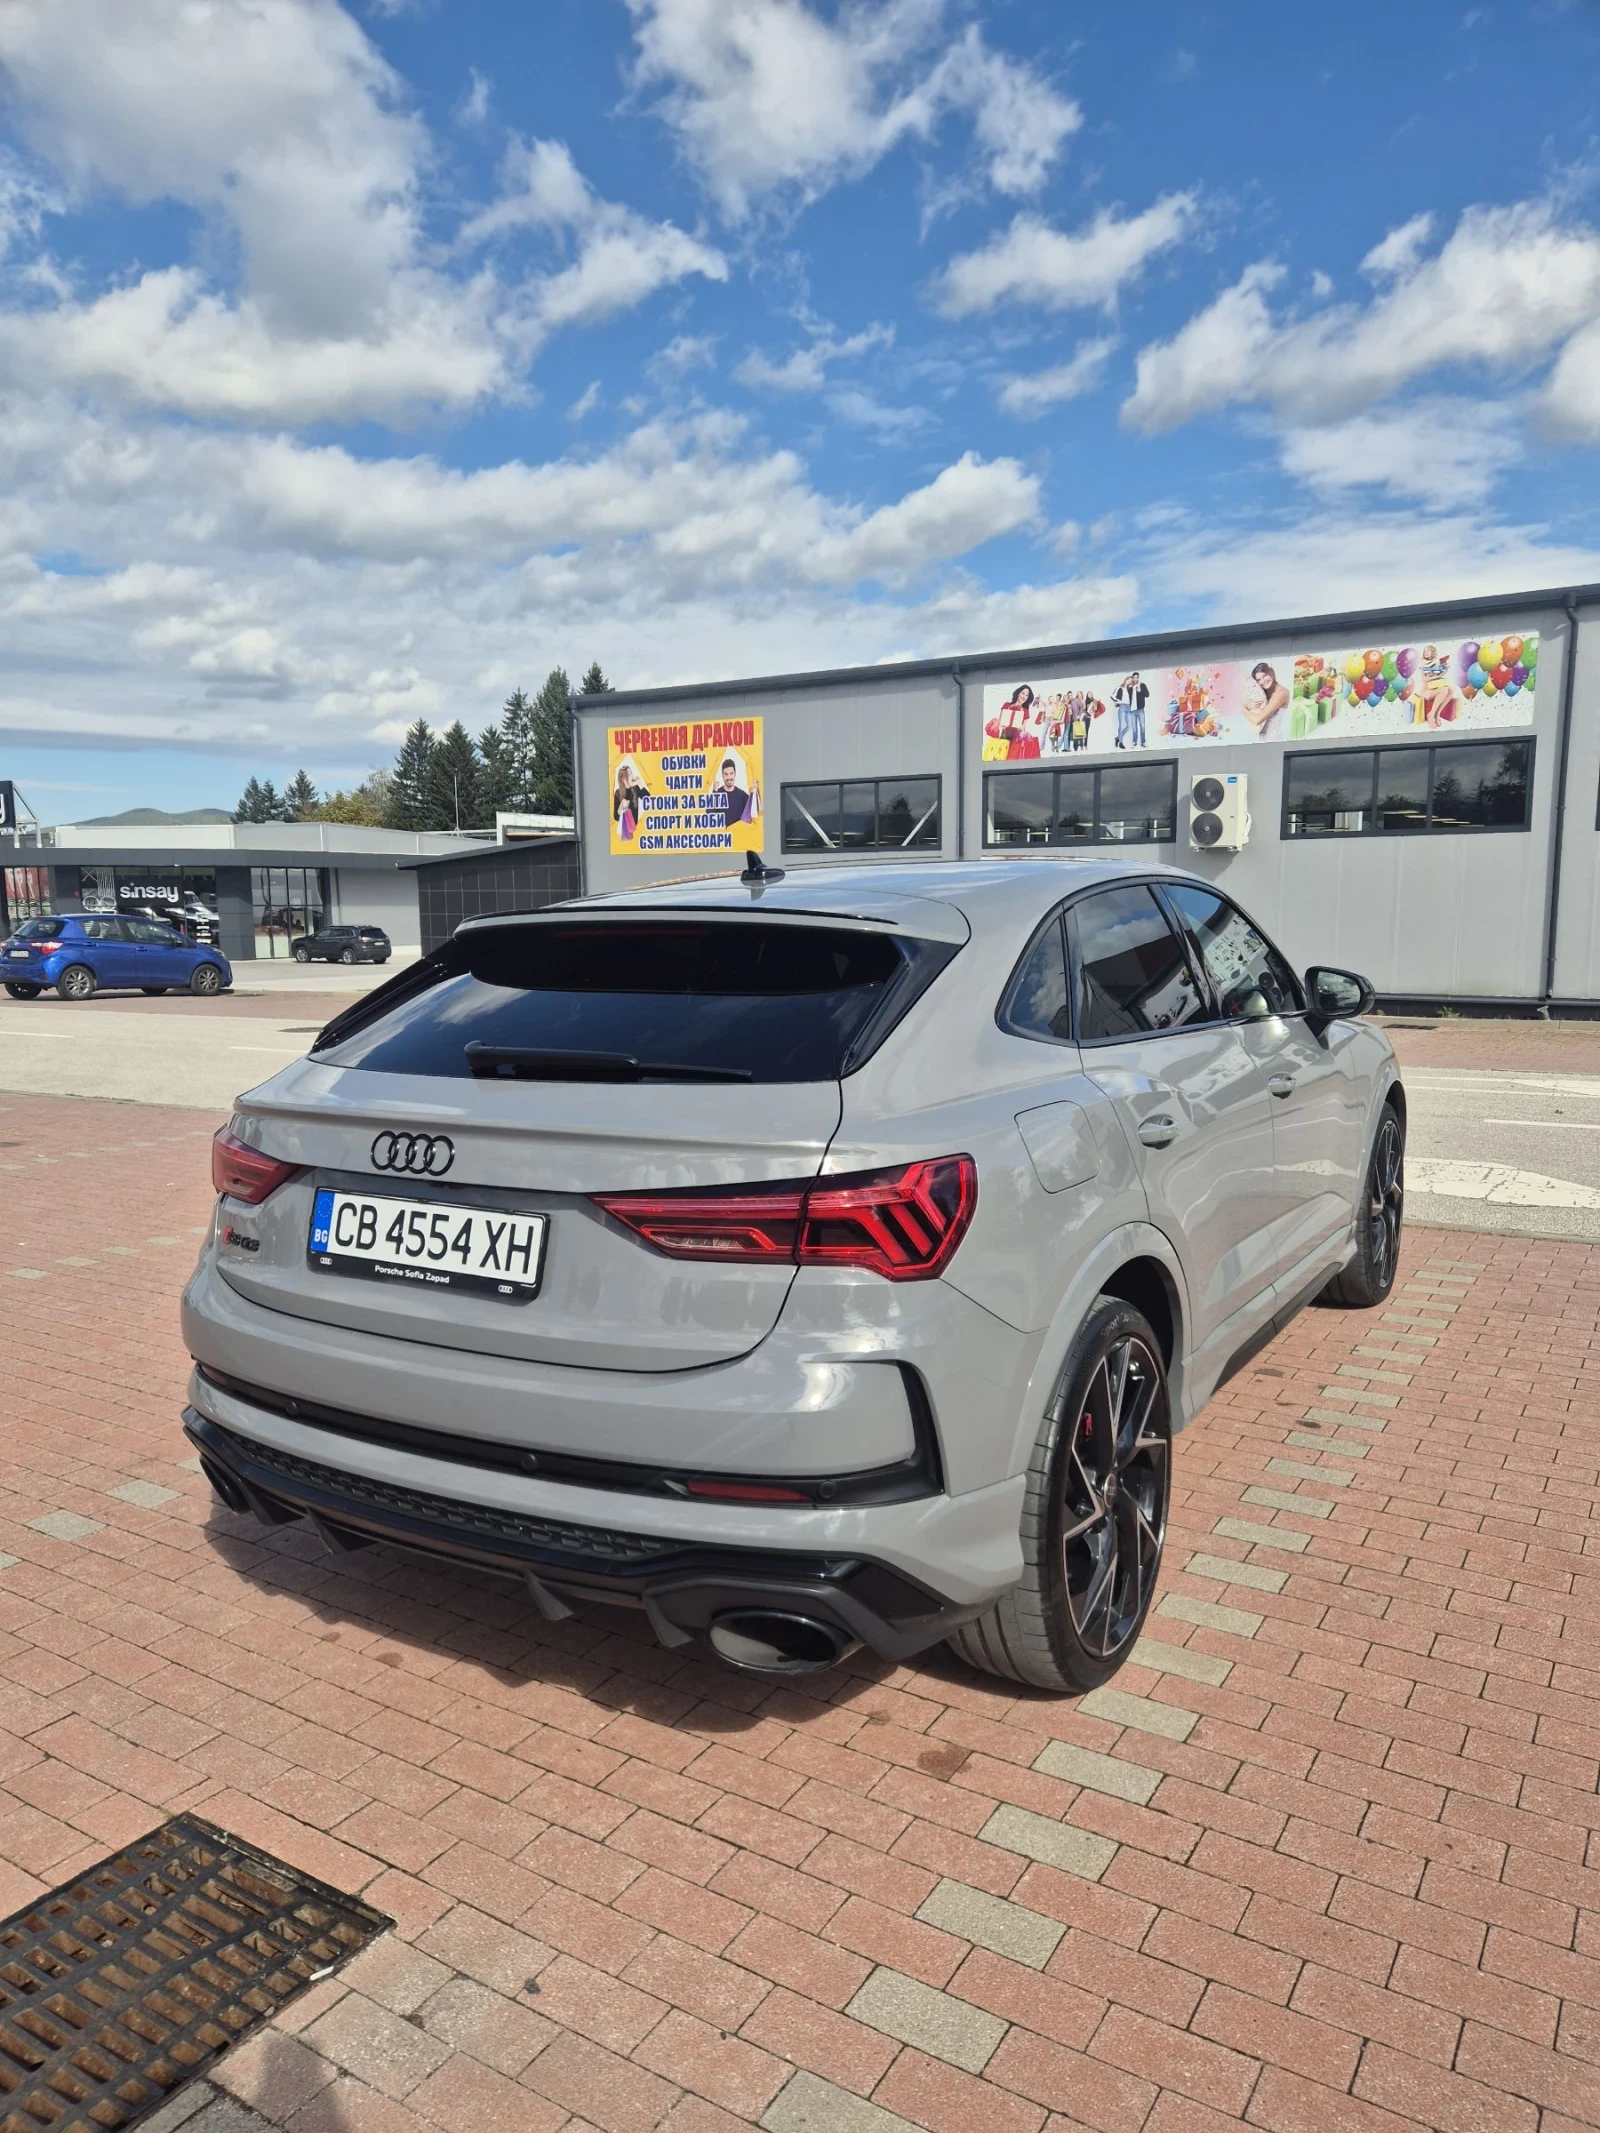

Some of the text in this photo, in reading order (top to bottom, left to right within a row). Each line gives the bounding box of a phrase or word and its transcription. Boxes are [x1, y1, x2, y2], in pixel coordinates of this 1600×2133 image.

[614, 721, 754, 754] ЧЕРВЕНИЯ ДРАКОН
[661, 754, 706, 771] ОБУВКИ
[665, 775, 703, 790] ЧАНТИ
[642, 793, 728, 811] СТОКИ ЗА БИТА
[646, 813, 725, 830] СПОРТ И ХОБИ
[639, 834, 732, 850] GSM АКСЕСОАРИ
[120, 882, 179, 903] sinsay
[314, 1228, 328, 1244] BG
[385, 1209, 473, 1265] 4554
[374, 1264, 450, 1284] Porsche Sofia Zapad
